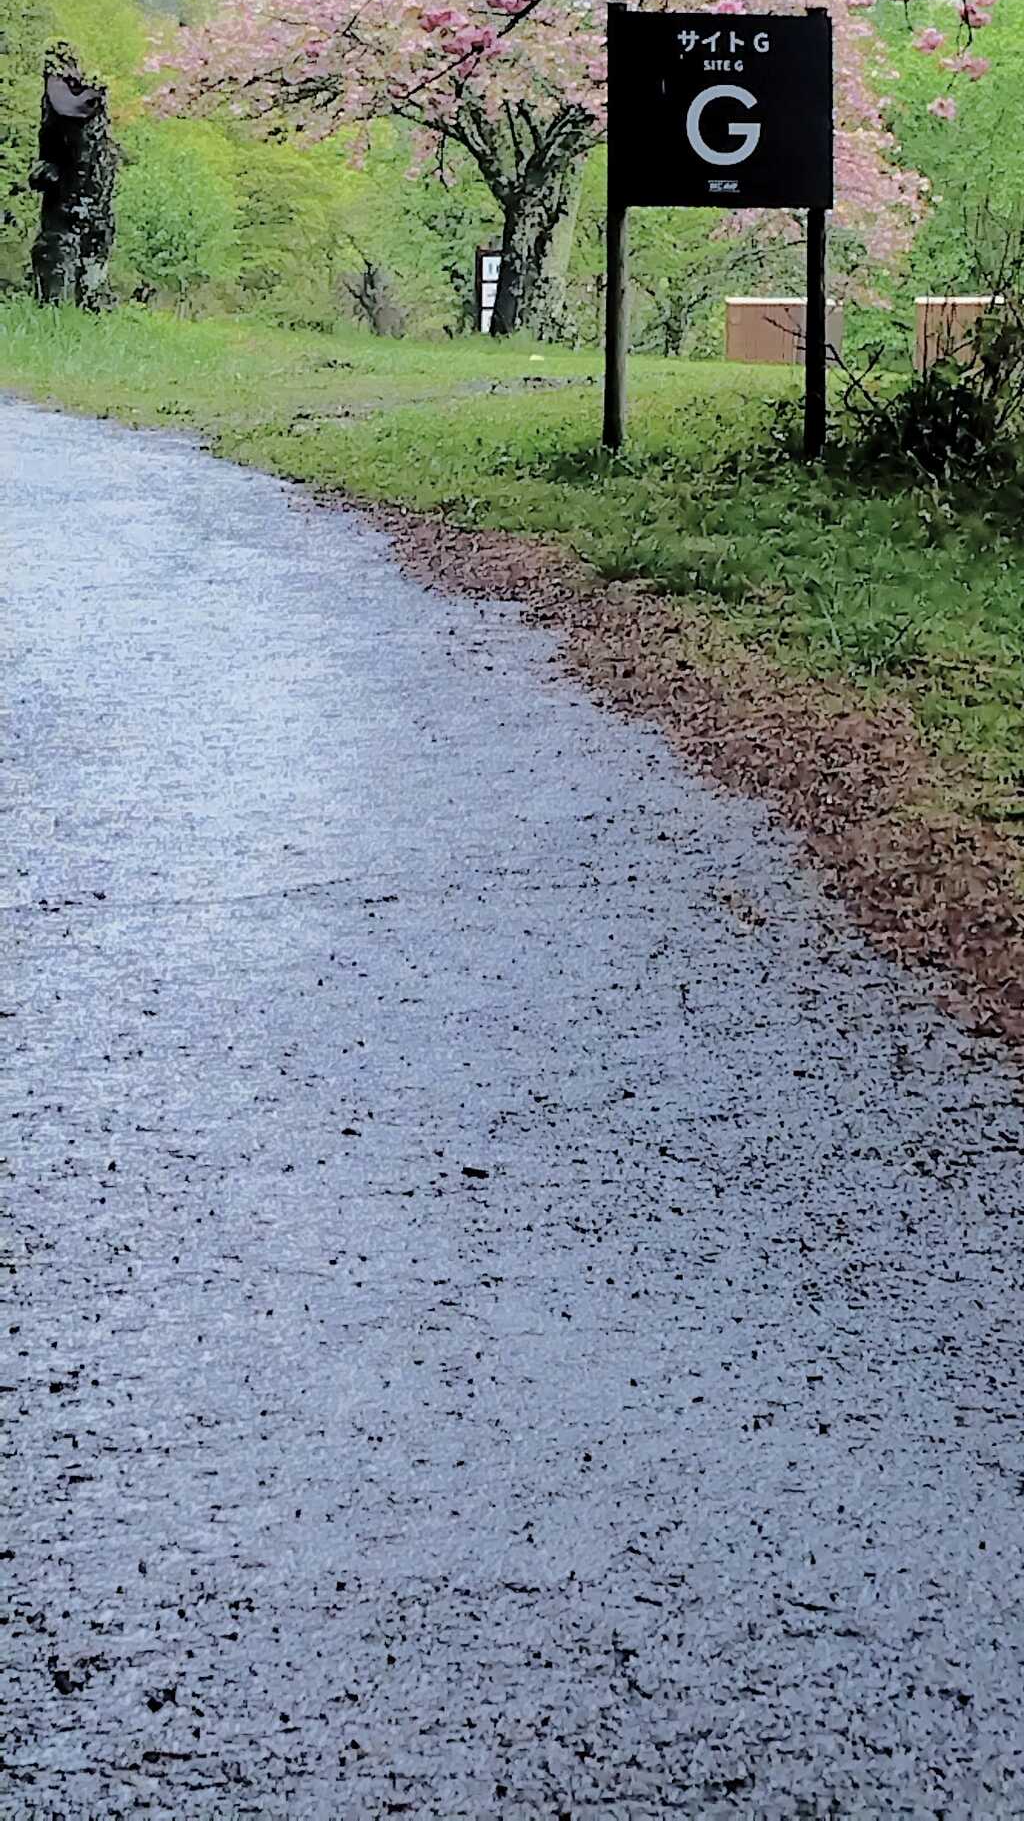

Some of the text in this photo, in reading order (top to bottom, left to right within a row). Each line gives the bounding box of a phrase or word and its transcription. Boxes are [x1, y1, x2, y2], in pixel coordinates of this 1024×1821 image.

[677, 30, 770, 53] サイト G
[703, 59, 744, 72] SITE G
[686, 84, 762, 166] G
